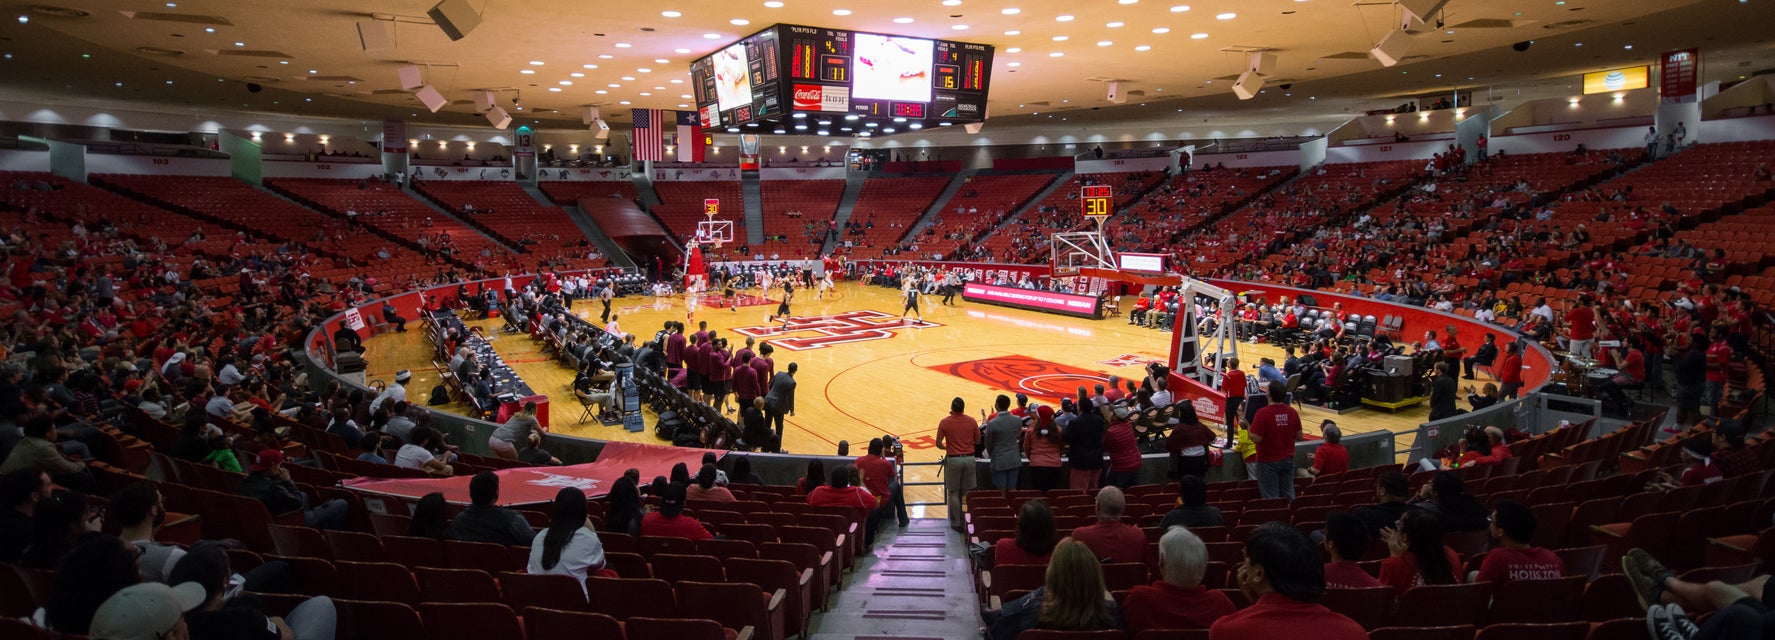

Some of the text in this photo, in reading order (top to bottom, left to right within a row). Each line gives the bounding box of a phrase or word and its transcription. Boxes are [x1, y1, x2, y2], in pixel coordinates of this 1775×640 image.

[826, 41, 831, 49] 4
[952, 52, 957, 61] 4
[1669, 52, 1690, 62] NIT
[834, 67, 844, 80] 11
[944, 76, 954, 88] 15
[518, 135, 530, 147] 13
[1086, 187, 1109, 196] 13:25
[1086, 198, 1107, 215] 30
[1509, 570, 1561, 580] HOUSTON
